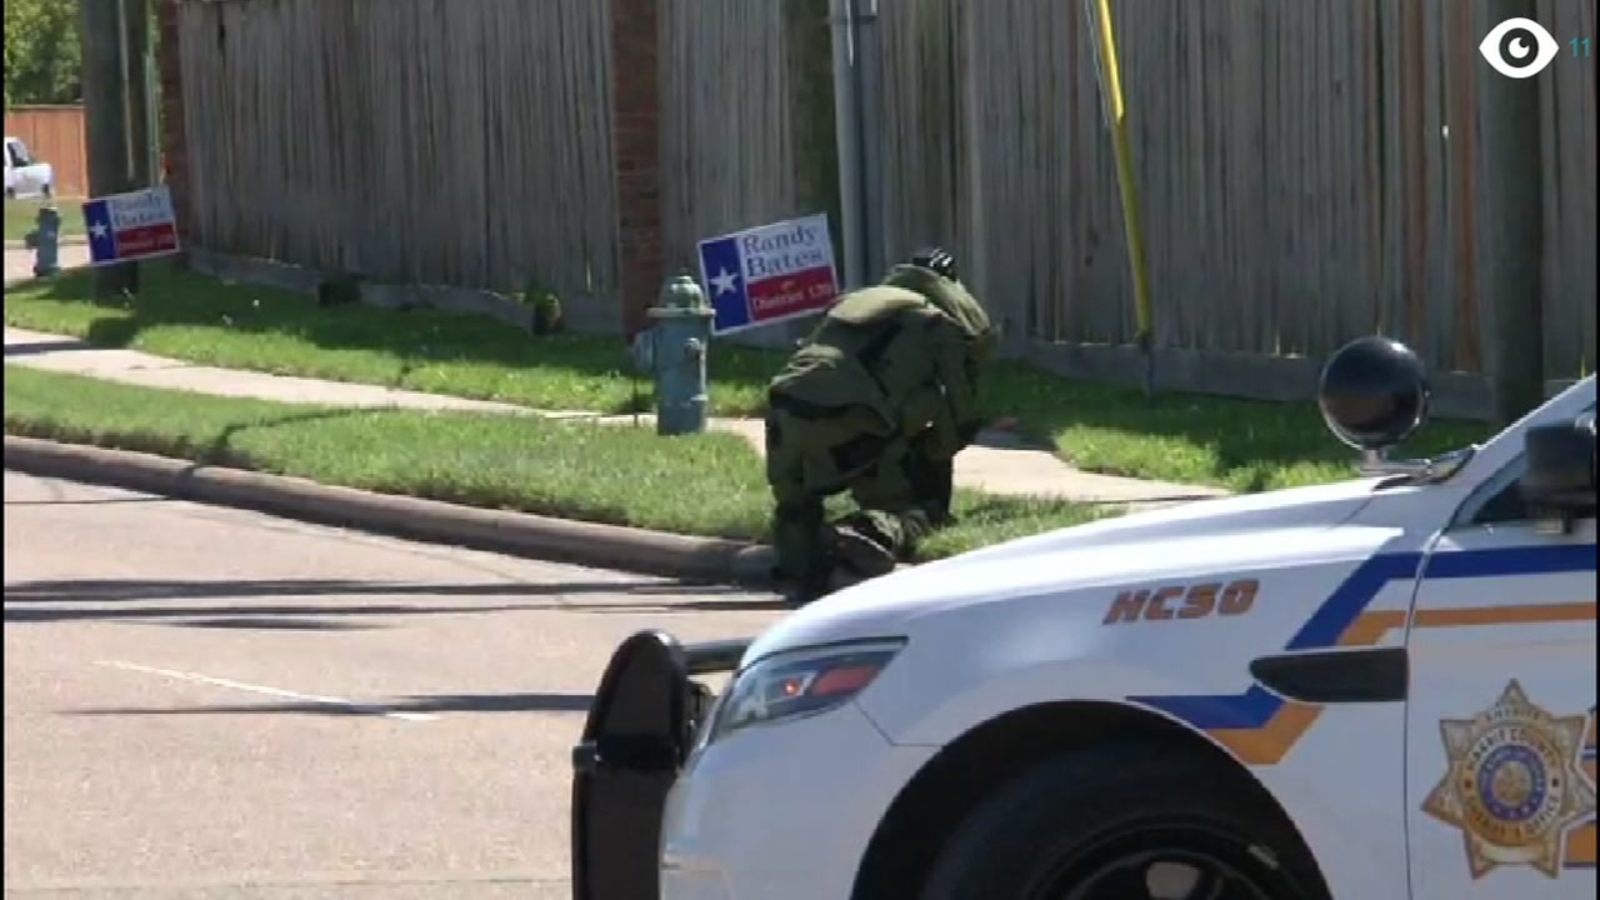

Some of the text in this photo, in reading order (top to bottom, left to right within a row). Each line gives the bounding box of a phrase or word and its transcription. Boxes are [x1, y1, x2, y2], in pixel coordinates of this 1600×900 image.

[743, 225, 818, 255] Randy
[746, 249, 823, 277] Bates
[1102, 579, 1260, 626] HCSO
